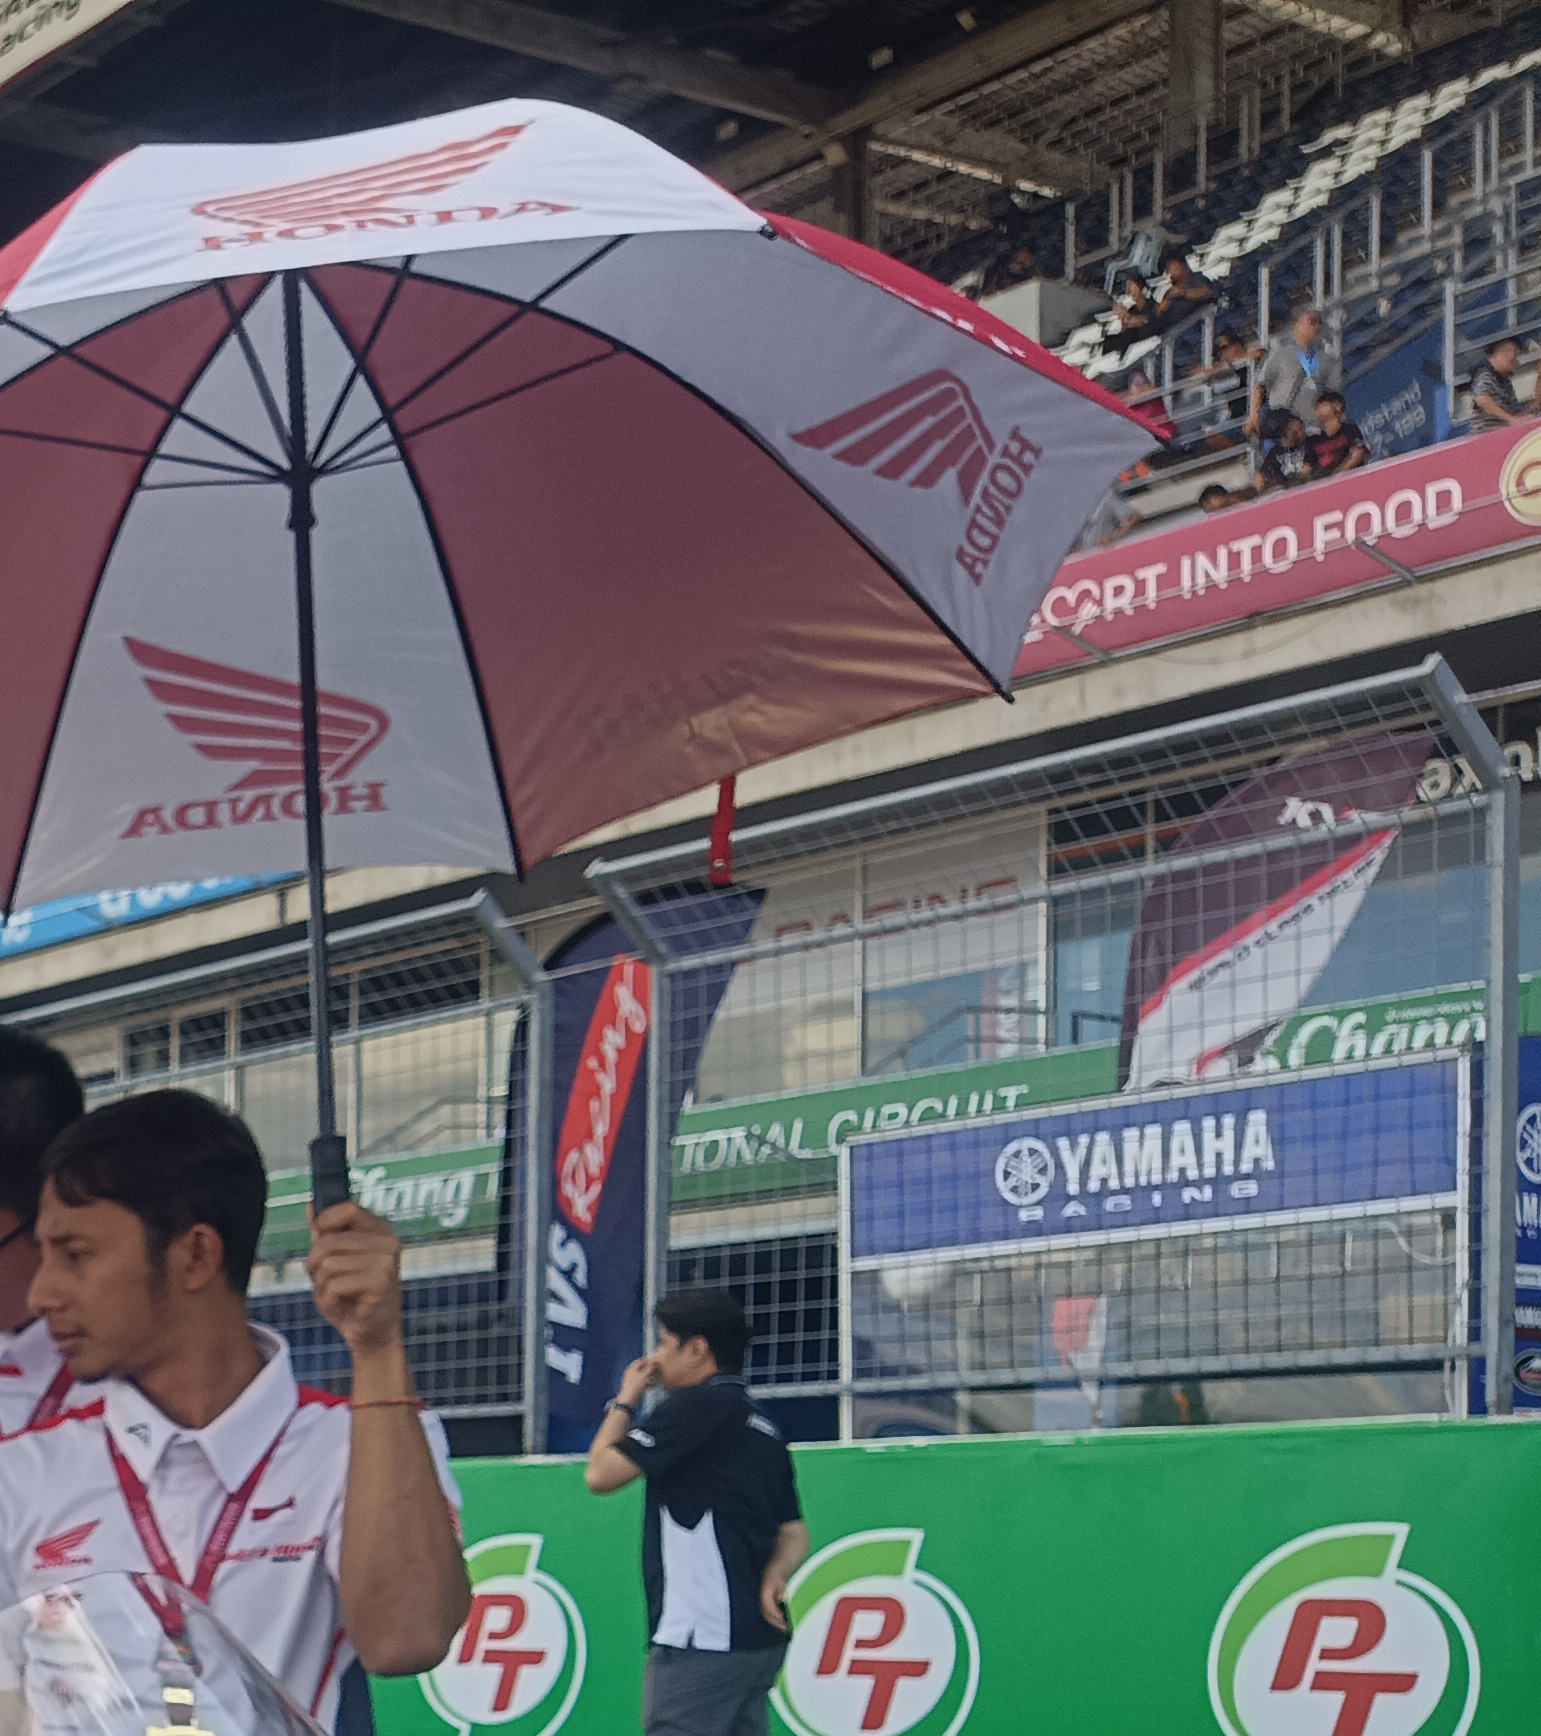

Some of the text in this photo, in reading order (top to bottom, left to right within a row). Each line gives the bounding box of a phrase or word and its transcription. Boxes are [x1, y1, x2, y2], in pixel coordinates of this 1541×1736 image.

[195, 199, 584, 252] HONDA
[1179, 525, 1298, 599] INTO
[1313, 477, 1463, 562] FOOD
[1018, 1178, 1259, 1224] RACING
[1054, 1109, 1276, 1195] YAMAHA
[460, 1592, 546, 1713] PT
[815, 1595, 931, 1732] PT
